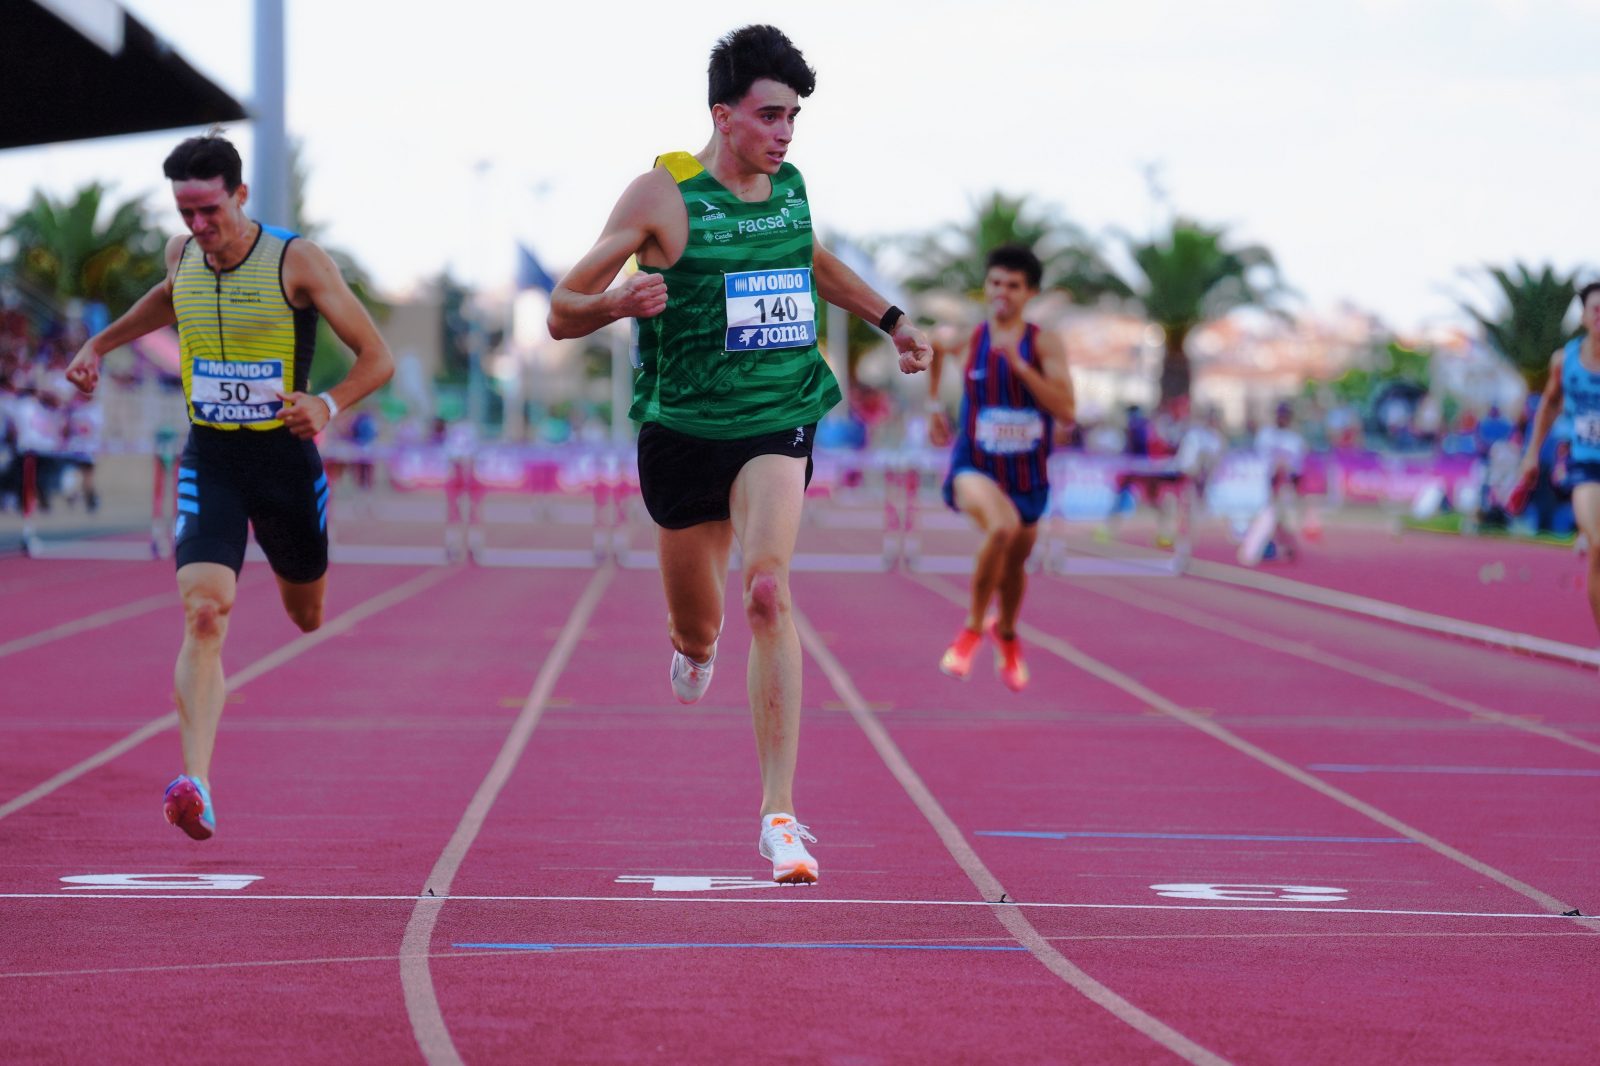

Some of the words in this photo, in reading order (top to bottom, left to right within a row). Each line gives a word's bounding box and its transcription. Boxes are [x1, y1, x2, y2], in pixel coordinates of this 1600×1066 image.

[737, 215, 787, 234] Facsa
[748, 273, 804, 292] MONDO
[753, 296, 799, 323] 140
[757, 325, 809, 346] Joma
[208, 361, 274, 378] MONDO
[219, 382, 250, 402] 50
[214, 404, 273, 422] Joma
